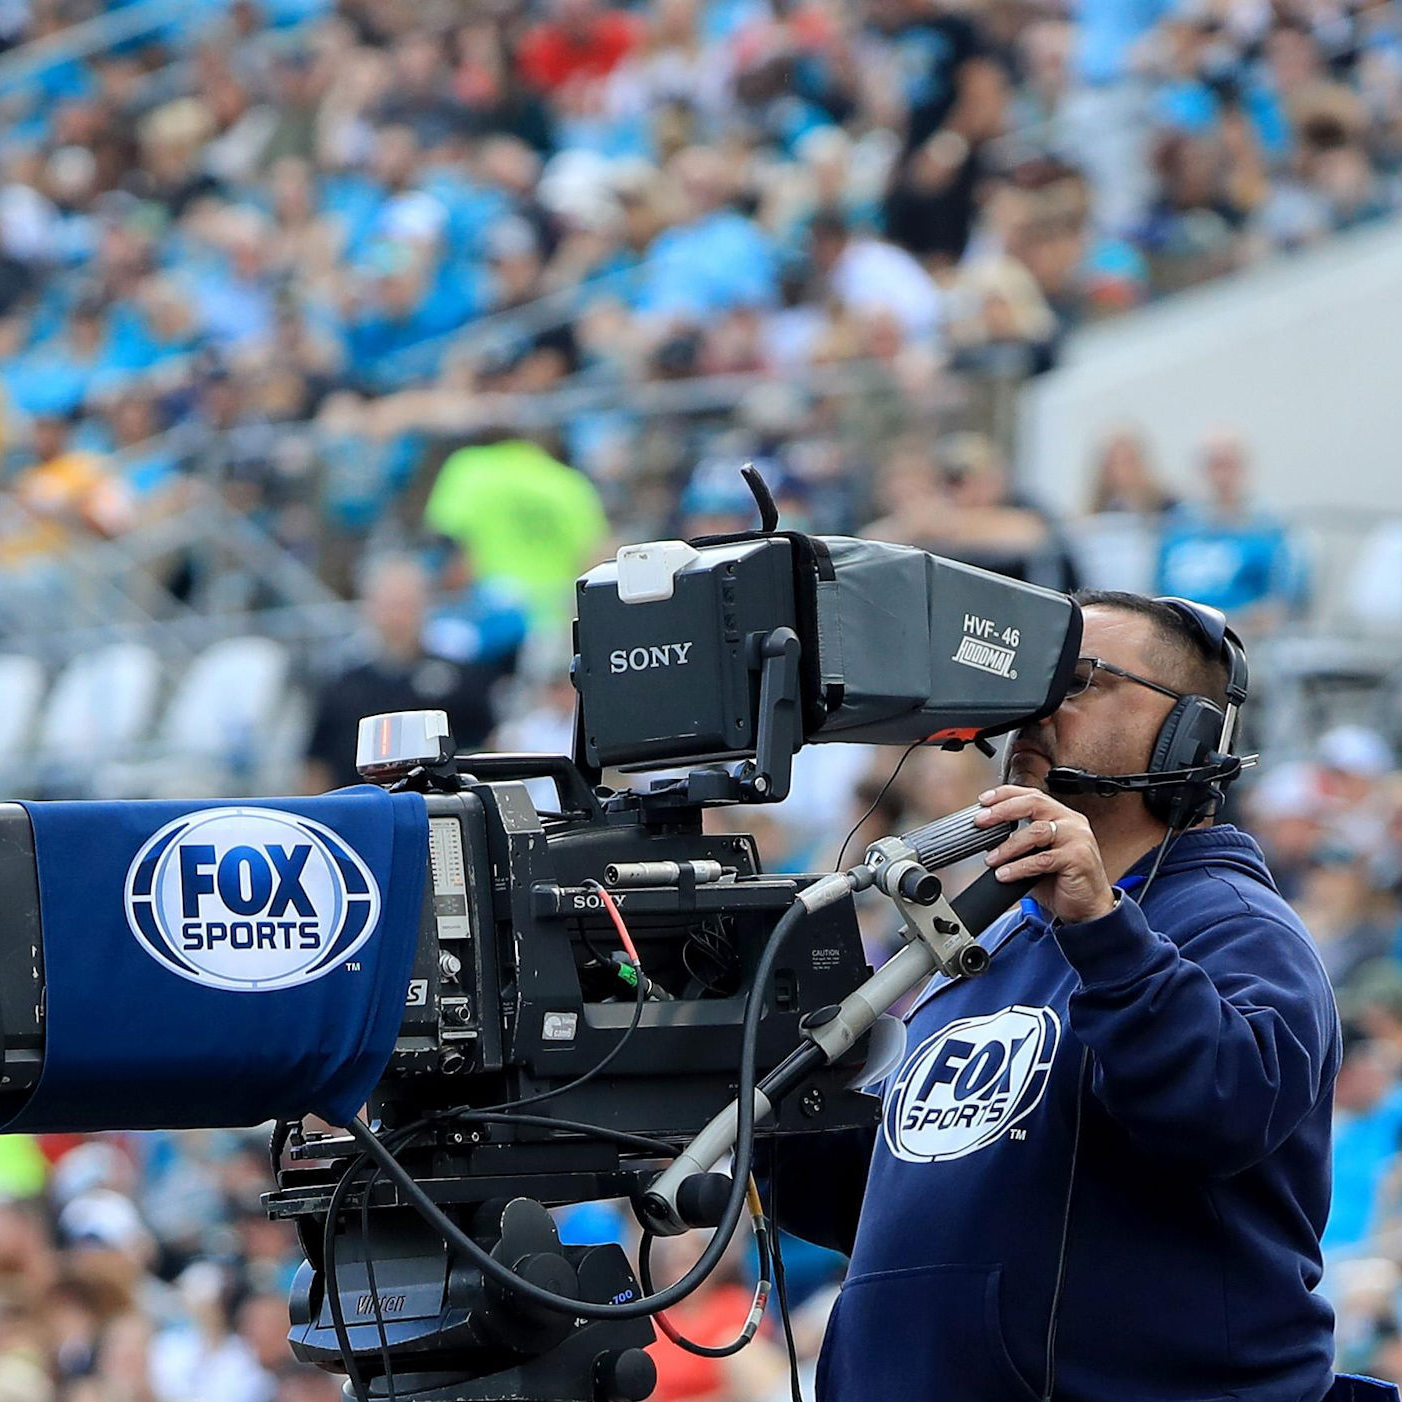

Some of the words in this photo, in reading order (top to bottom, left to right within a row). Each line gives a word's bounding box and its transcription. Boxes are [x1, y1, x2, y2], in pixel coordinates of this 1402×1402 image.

[610, 642, 693, 674] SONY
[951, 635, 1017, 678] HOODMAN
[179, 844, 318, 919] FOX
[182, 921, 321, 951] SPORTS
[345, 962, 361, 972] TM
[915, 1027, 1037, 1102] FOX
[1009, 1128, 1027, 1140] TM
